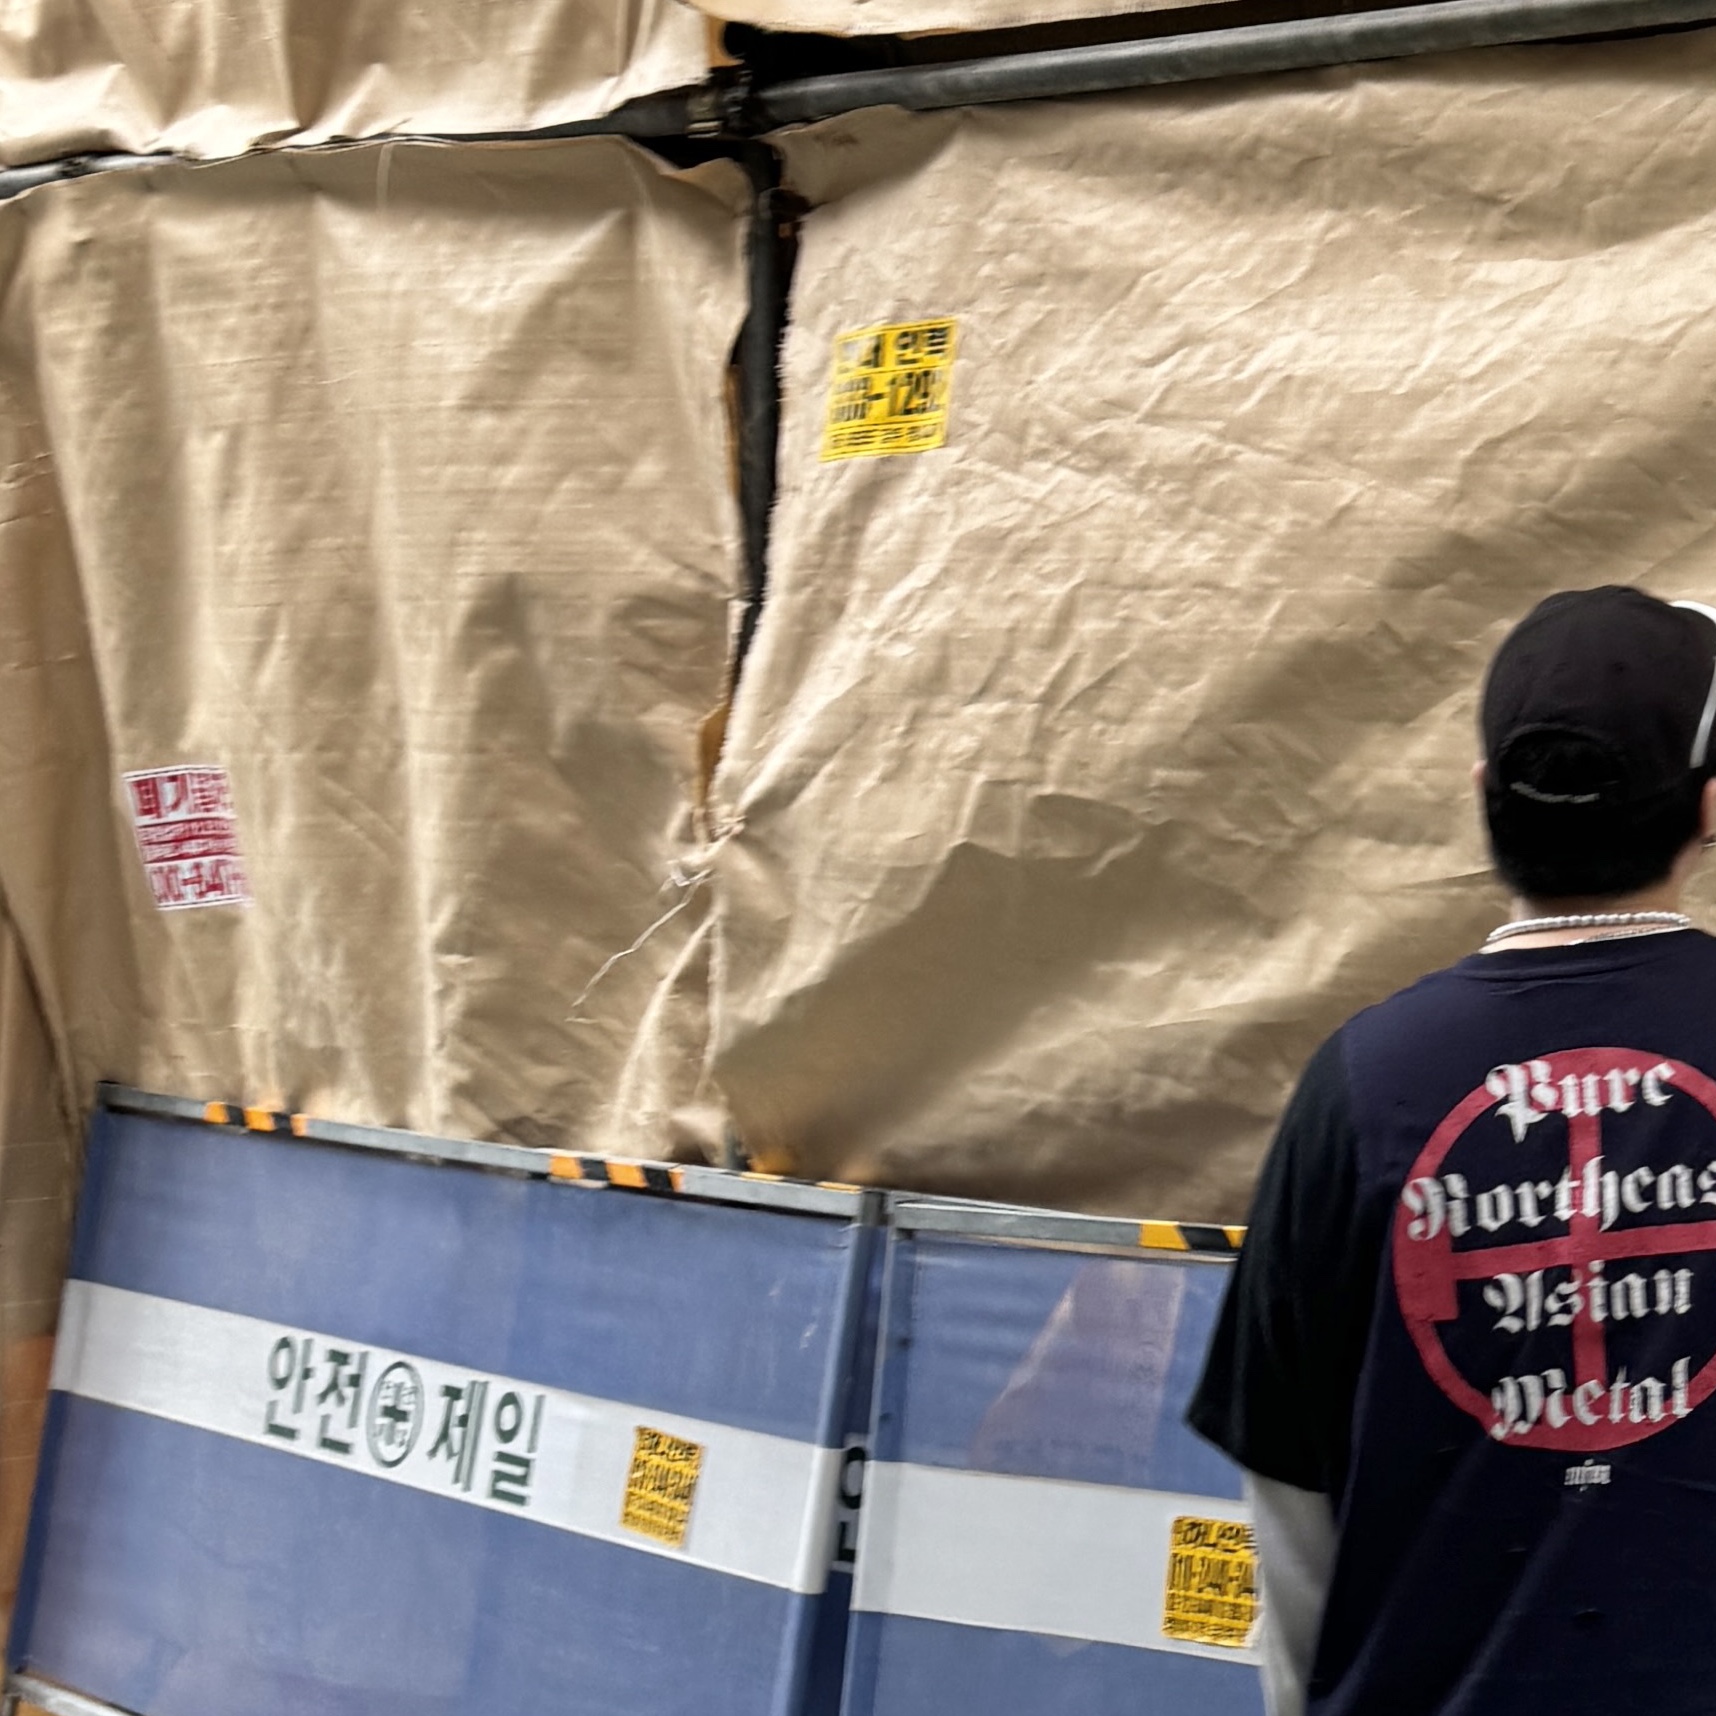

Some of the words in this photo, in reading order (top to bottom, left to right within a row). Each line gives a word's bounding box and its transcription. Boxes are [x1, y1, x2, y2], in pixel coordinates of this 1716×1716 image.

[1485, 1059, 1677, 1144] Pure
[1482, 1259, 1695, 1335] Asian
[265, 1335, 371, 1456] 안전
[426, 1379, 546, 1507] 제일
[1489, 1355, 1695, 1441] Metal
